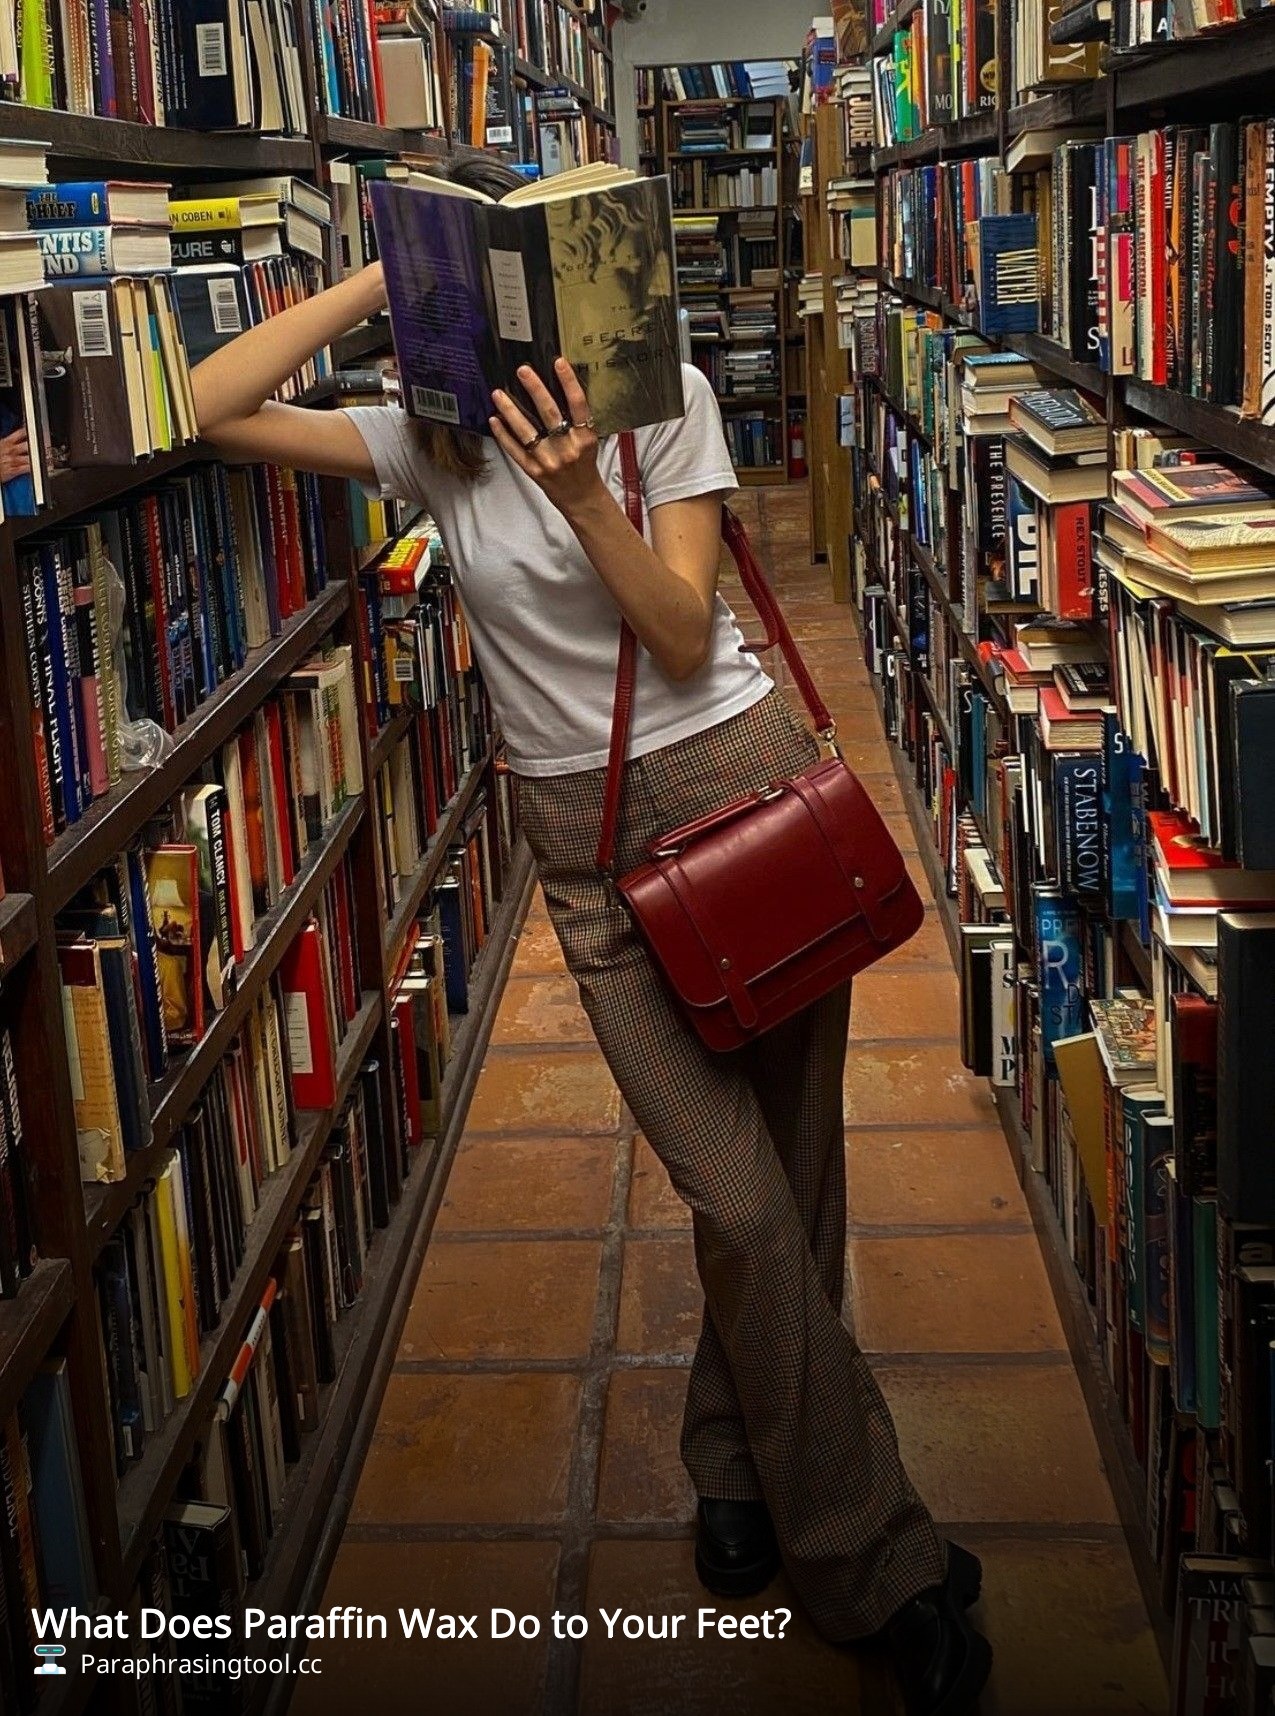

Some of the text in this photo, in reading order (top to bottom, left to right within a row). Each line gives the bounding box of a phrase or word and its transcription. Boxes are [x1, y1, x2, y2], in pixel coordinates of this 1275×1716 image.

[1164, 140, 1173, 209] JULIE SMITH
[182, 210, 214, 222] COBEN
[38, 231, 93, 254] NTIS
[43, 254, 80, 275] ND
[1264, 283, 1273, 318] TODD
[1264, 323, 1273, 368] SCOTT
[989, 444, 1006, 539] THE PRESENCE
[1076, 516, 1087, 584] REX STOUT
[33, 567, 48, 625] COONTS
[23, 584, 42, 709] STEPHEN COONTS
[43, 654, 65, 785] FINAL FLIGHT
[210, 807, 221, 839] TOM
[1074, 767, 1099, 892] STABENOW
[212, 839, 226, 886] CLANCY
[217, 889, 227, 915] DEAD
